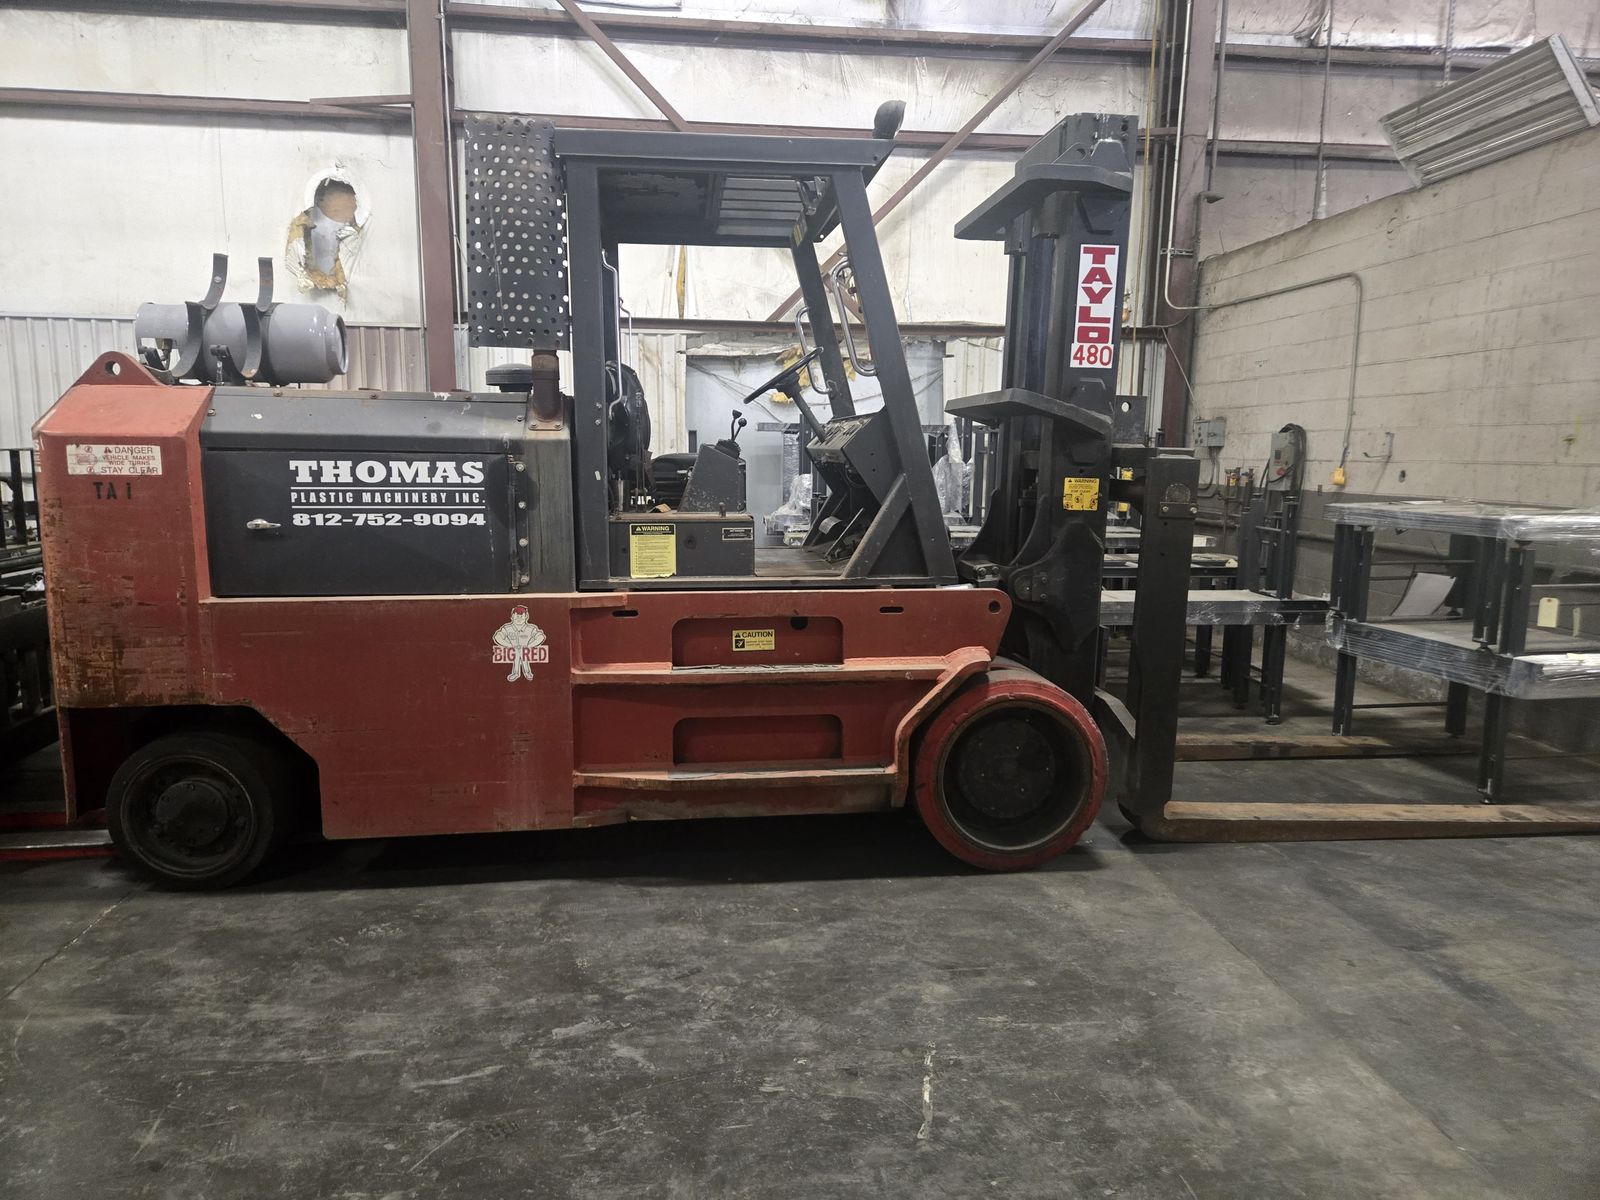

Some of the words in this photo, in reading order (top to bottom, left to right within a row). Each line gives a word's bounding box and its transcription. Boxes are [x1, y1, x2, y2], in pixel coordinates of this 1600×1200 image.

[1073, 344, 1113, 366] 480
[114, 446, 153, 454] DANGER
[289, 460, 485, 484] THOMAS
[291, 492, 353, 503] PLASTIC
[362, 492, 447, 503] MACHINERY
[455, 492, 486, 503] INC.
[292, 513, 486, 526] 812-752-9094
[494, 647, 516, 661] BIG
[522, 647, 547, 661] RED
